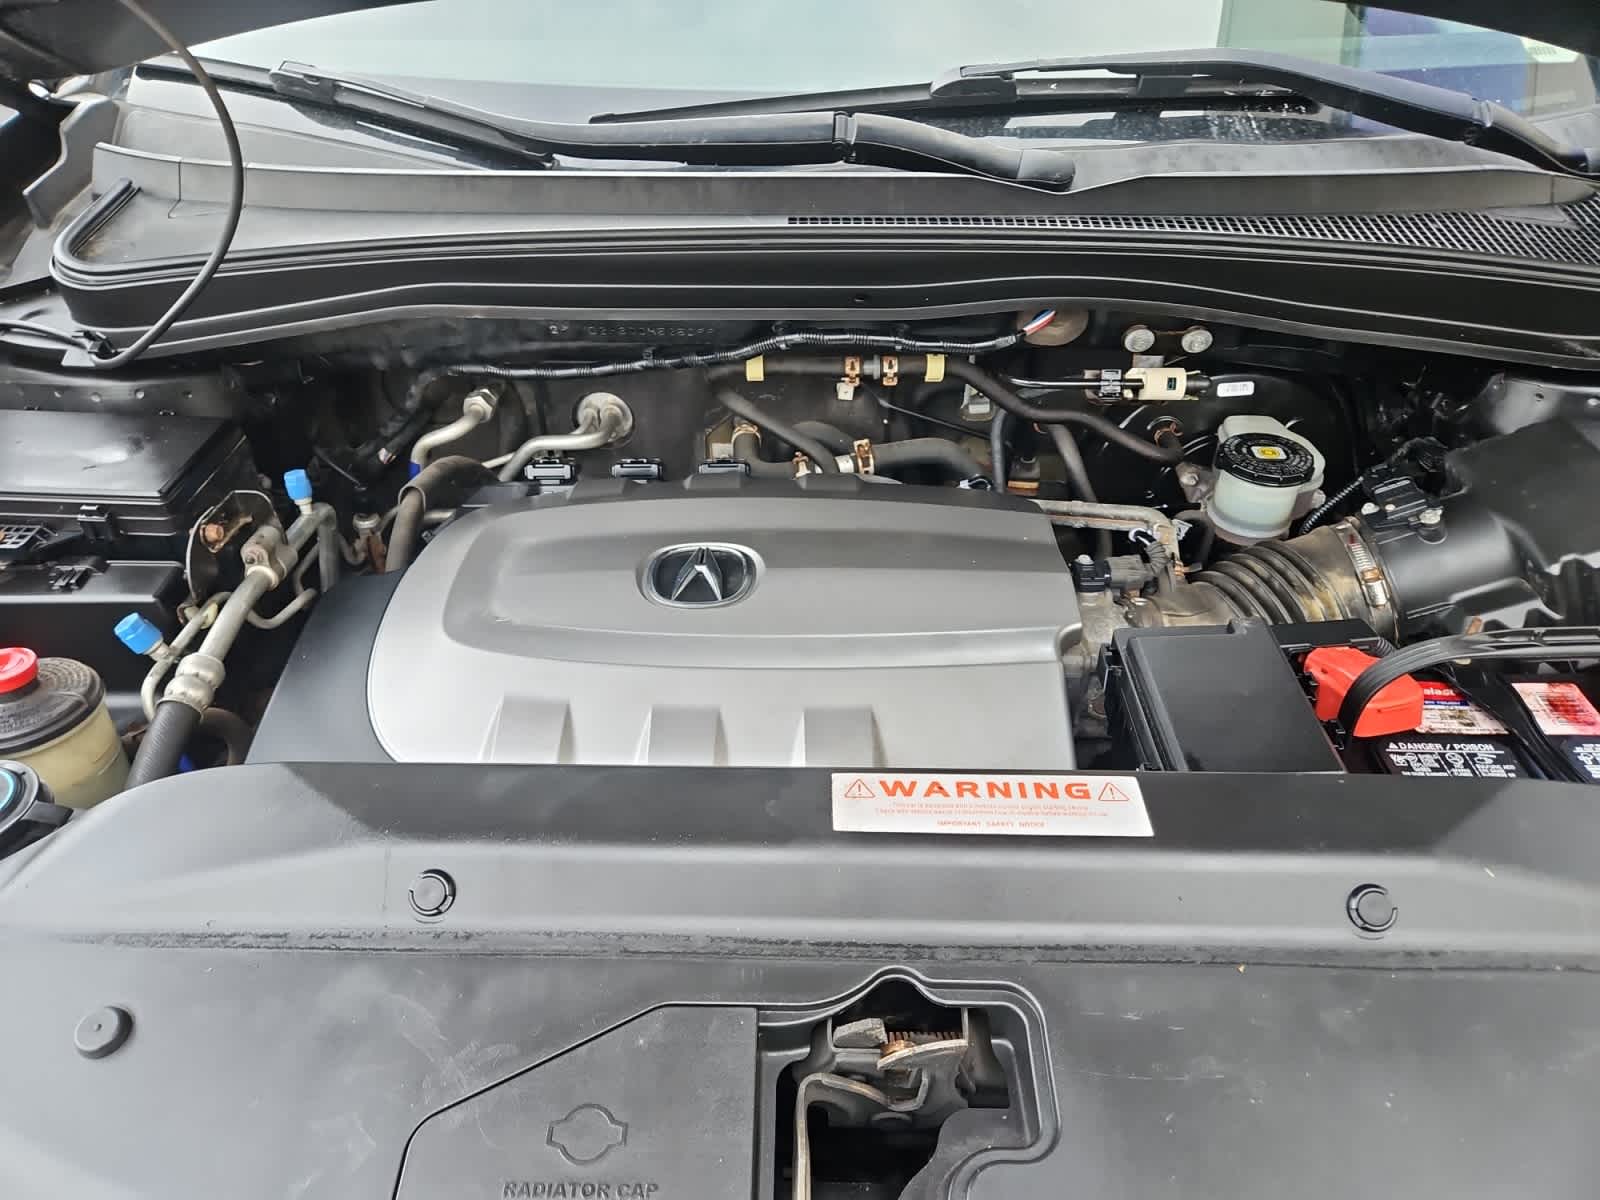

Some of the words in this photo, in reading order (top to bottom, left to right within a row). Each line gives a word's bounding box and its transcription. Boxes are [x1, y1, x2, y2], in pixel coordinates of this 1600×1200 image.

[1398, 742, 1443, 750] DANGER
[1453, 743, 1495, 751] POISON
[879, 780, 1091, 800] WARNING
[503, 1182, 611, 1199] RADIATOR
[617, 1183, 660, 1199] CAP
